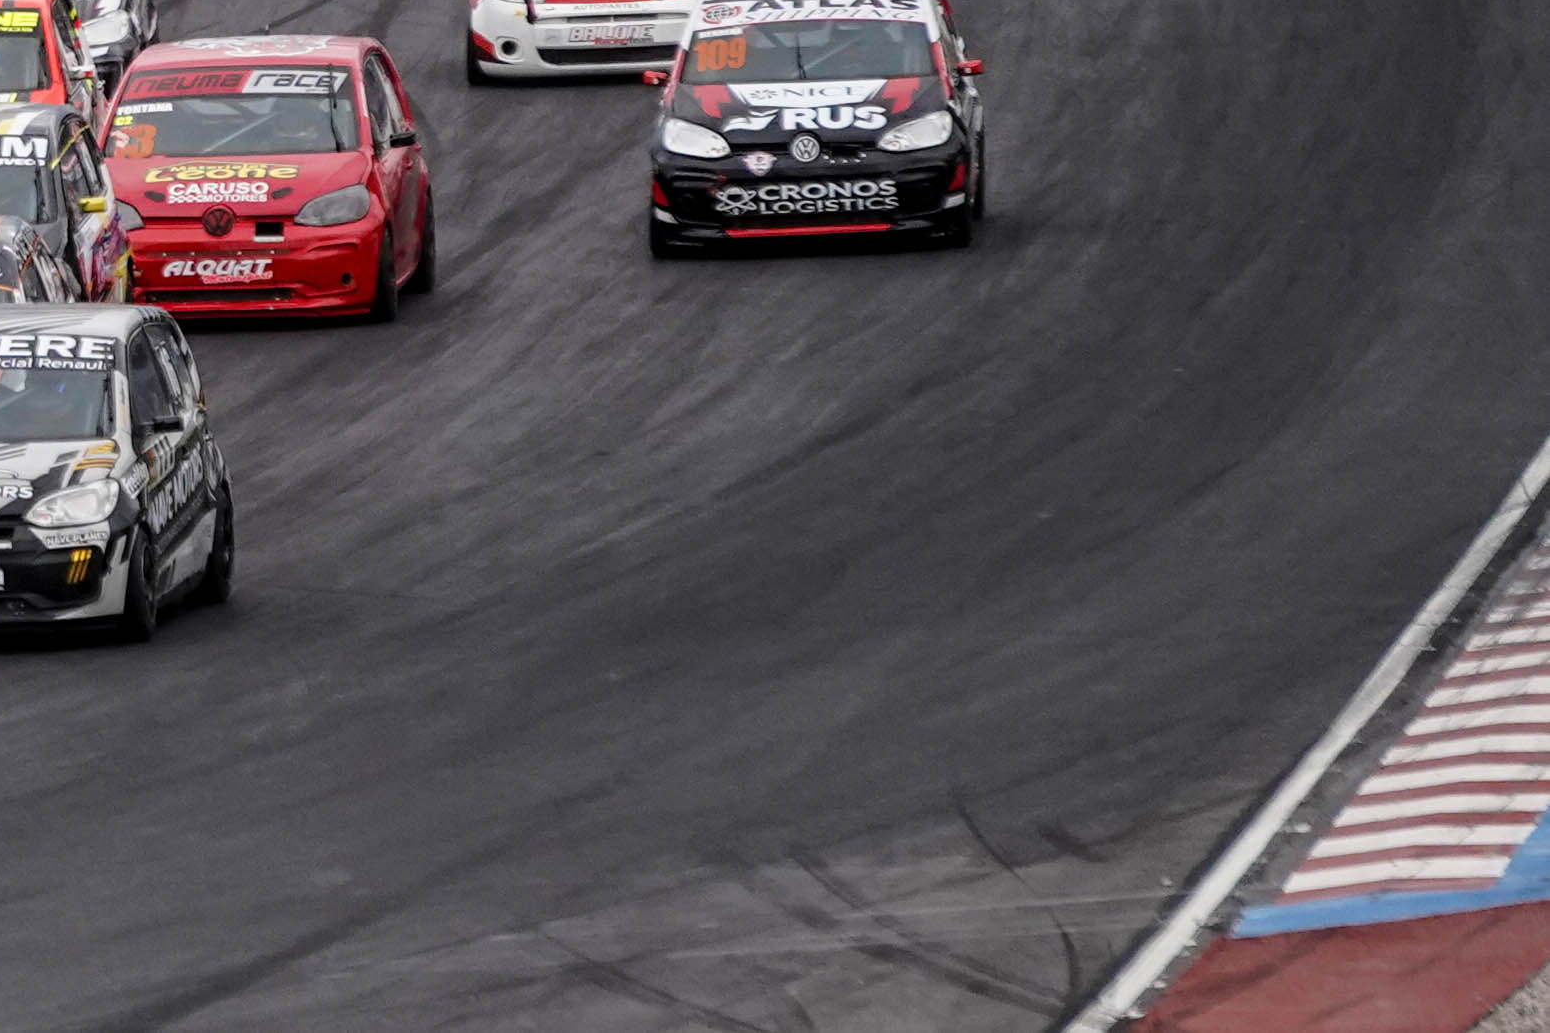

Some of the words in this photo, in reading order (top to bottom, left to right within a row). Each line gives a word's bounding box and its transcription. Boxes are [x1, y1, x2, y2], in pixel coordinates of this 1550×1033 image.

[693, 37, 747, 72] 109
[254, 73, 335, 89] race
[783, 85, 861, 97] NICE
[782, 105, 888, 131] RUS
[144, 165, 299, 183] Leone
[167, 181, 269, 196] CARUSO
[758, 180, 897, 201] CRONOS
[202, 193, 267, 204] MOTORES
[759, 196, 900, 215] LOGISTICS
